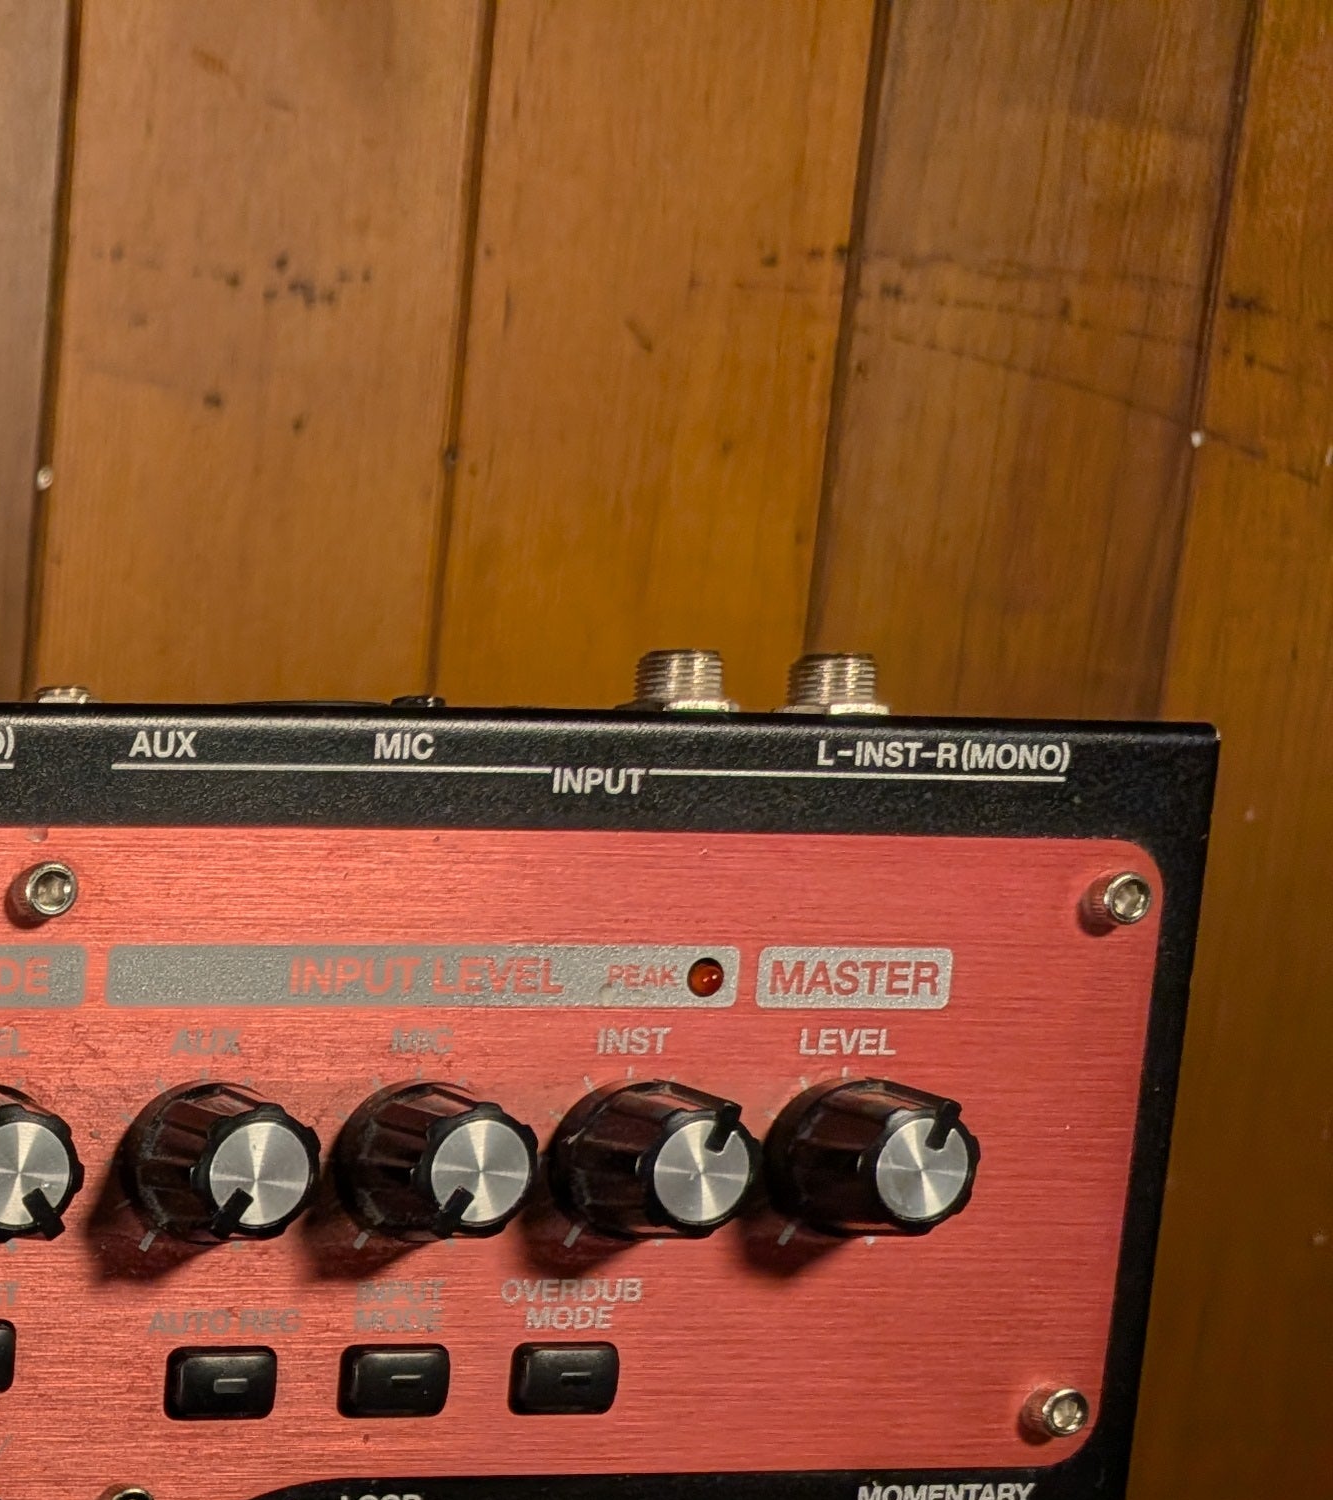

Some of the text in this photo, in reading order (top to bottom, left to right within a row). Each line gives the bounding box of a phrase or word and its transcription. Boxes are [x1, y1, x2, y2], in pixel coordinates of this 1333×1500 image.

[129, 731, 197, 758] AUX
[374, 732, 438, 760] MIC
[552, 768, 645, 795] INPUT
[288, 956, 567, 996] INPUT LEVEL
[607, 964, 677, 988] PEAK
[769, 962, 939, 997] MASTER
[171, 1029, 242, 1055] AUX
[598, 1028, 671, 1054] INST
[799, 1029, 896, 1056] LEVEL
[356, 1280, 446, 1304] INPUT
[501, 1278, 643, 1302] OVERDUB
[148, 1309, 301, 1335] AUTO REC
[354, 1309, 444, 1333] MODE
[525, 1307, 614, 1330] MODE
